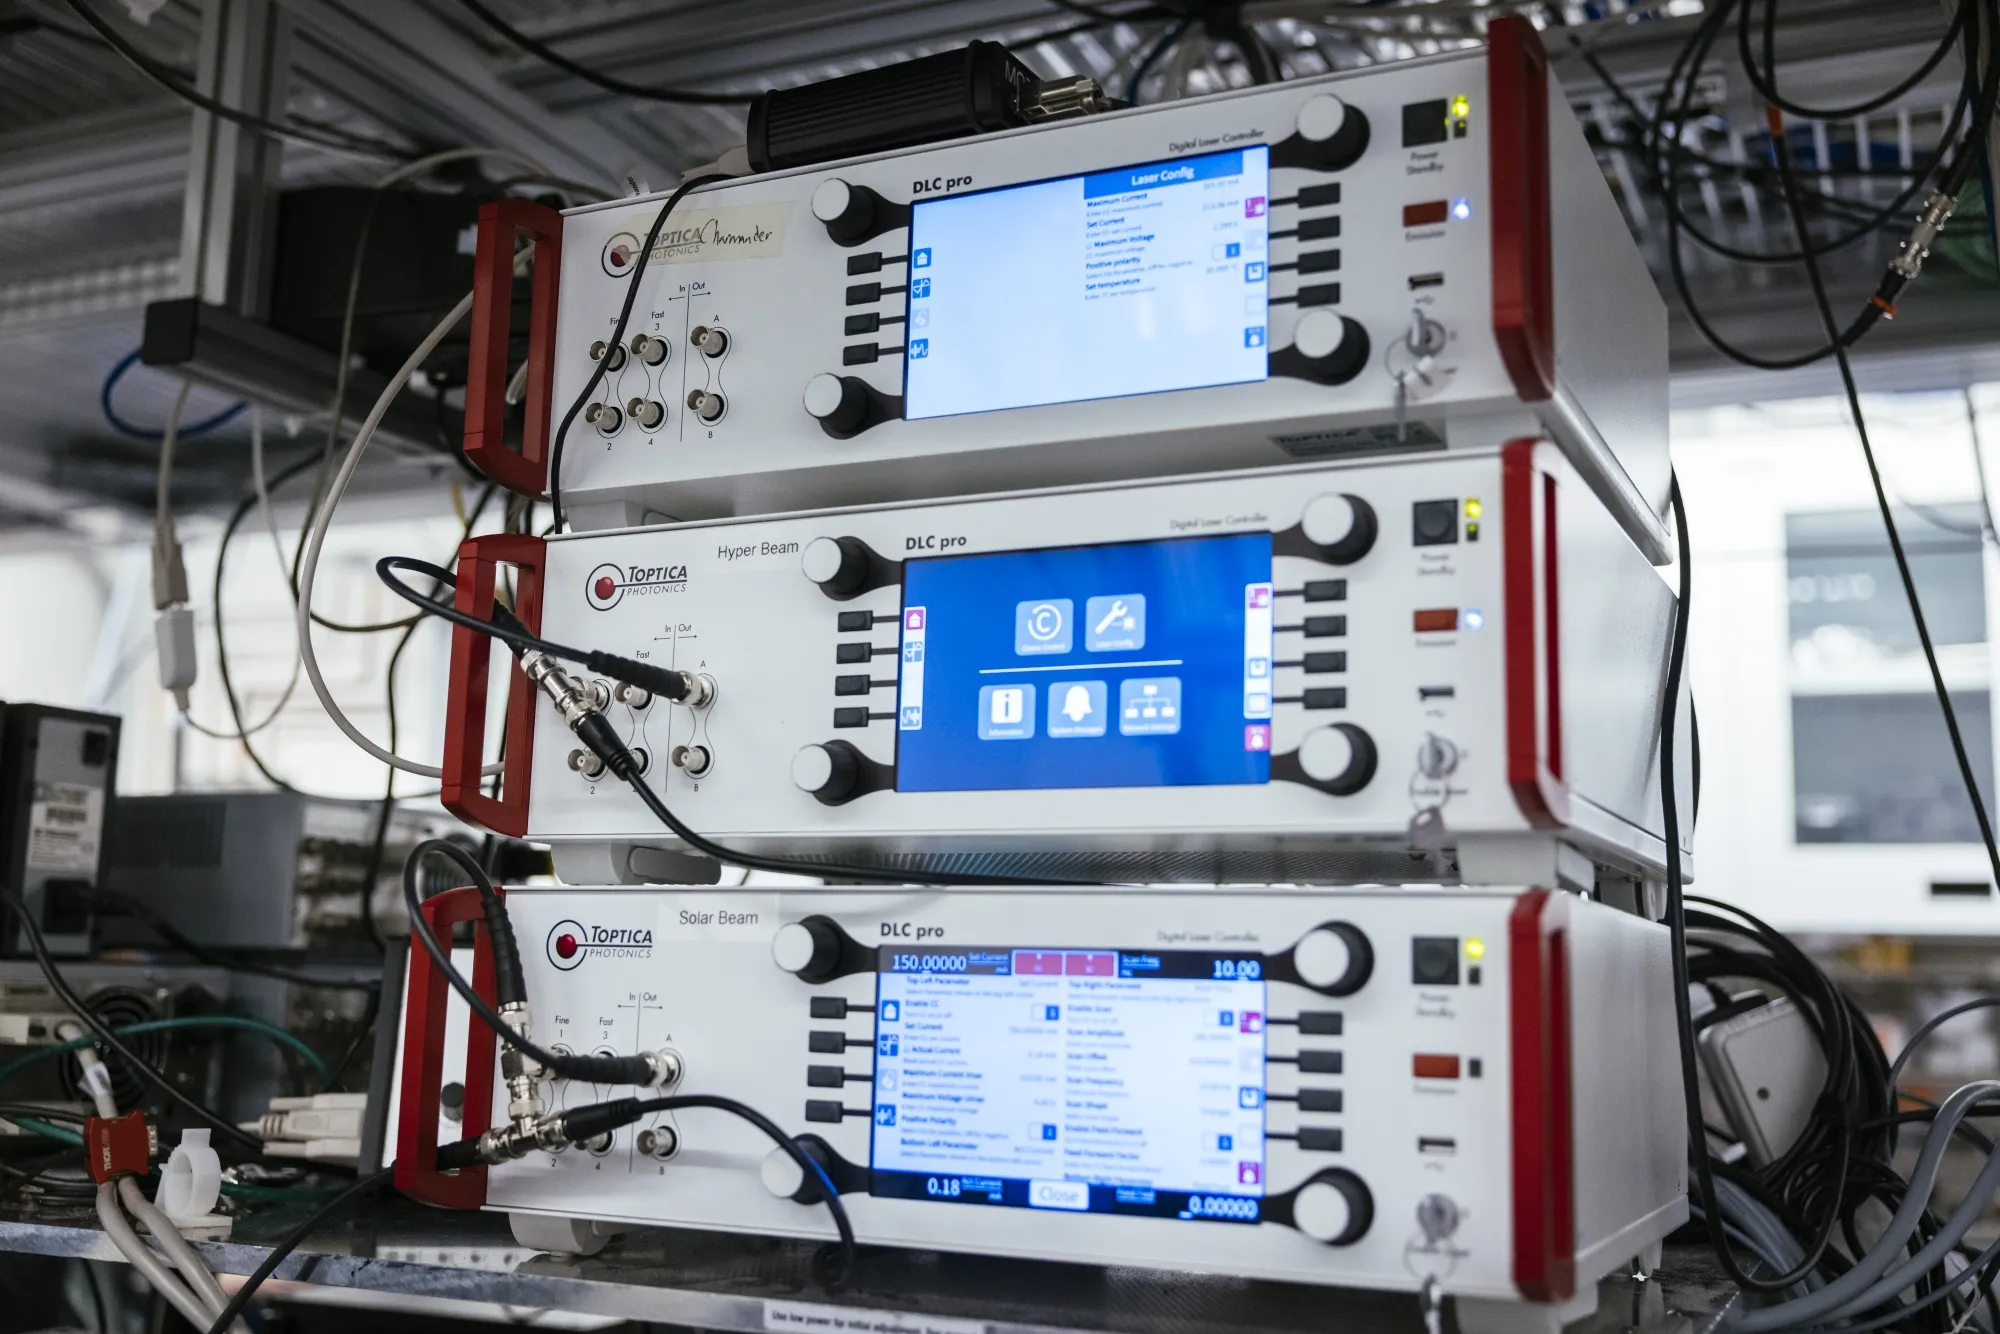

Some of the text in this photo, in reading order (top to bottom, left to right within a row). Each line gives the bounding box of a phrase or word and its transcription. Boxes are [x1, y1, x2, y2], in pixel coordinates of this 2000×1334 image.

[1131, 166, 1196, 187] Laser Config
[913, 176, 973, 194] DLC pro
[648, 245, 700, 260] HOTONICS
[1086, 260, 1112, 270] Positive
[1114, 256, 1141, 268] polarity
[692, 282, 706, 290] Out
[651, 311, 665, 320] Fast
[655, 322, 660, 331] 3
[607, 442, 612, 451] 2
[648, 438, 653, 446] 4
[906, 535, 967, 551] DLC pro
[718, 541, 799, 562] Hyper Beam
[629, 565, 688, 582] TOPTICA
[627, 583, 686, 596] PHOTONICS
[664, 623, 692, 633] In Out
[636, 650, 650, 659] Fast
[590, 783, 699, 795] 2 B
[679, 909, 759, 925] Solar Beam
[592, 926, 653, 944] TOPTICA
[881, 922, 944, 941] DLC pro
[589, 948, 652, 959] PHOTONICS
[892, 953, 967, 972] 150.00000
[1213, 959, 1261, 979] 10.00
[629, 992, 657, 1001] In Out
[555, 1015, 614, 1026] Fine Fast
[603, 1031, 608, 1040] 3
[665, 1034, 672, 1042] A
[551, 1158, 665, 1175] 2 4 B
[926, 1176, 961, 1197] 0.18
[1039, 1186, 1080, 1203] Close
[1188, 1195, 1260, 1220] 0.00000
